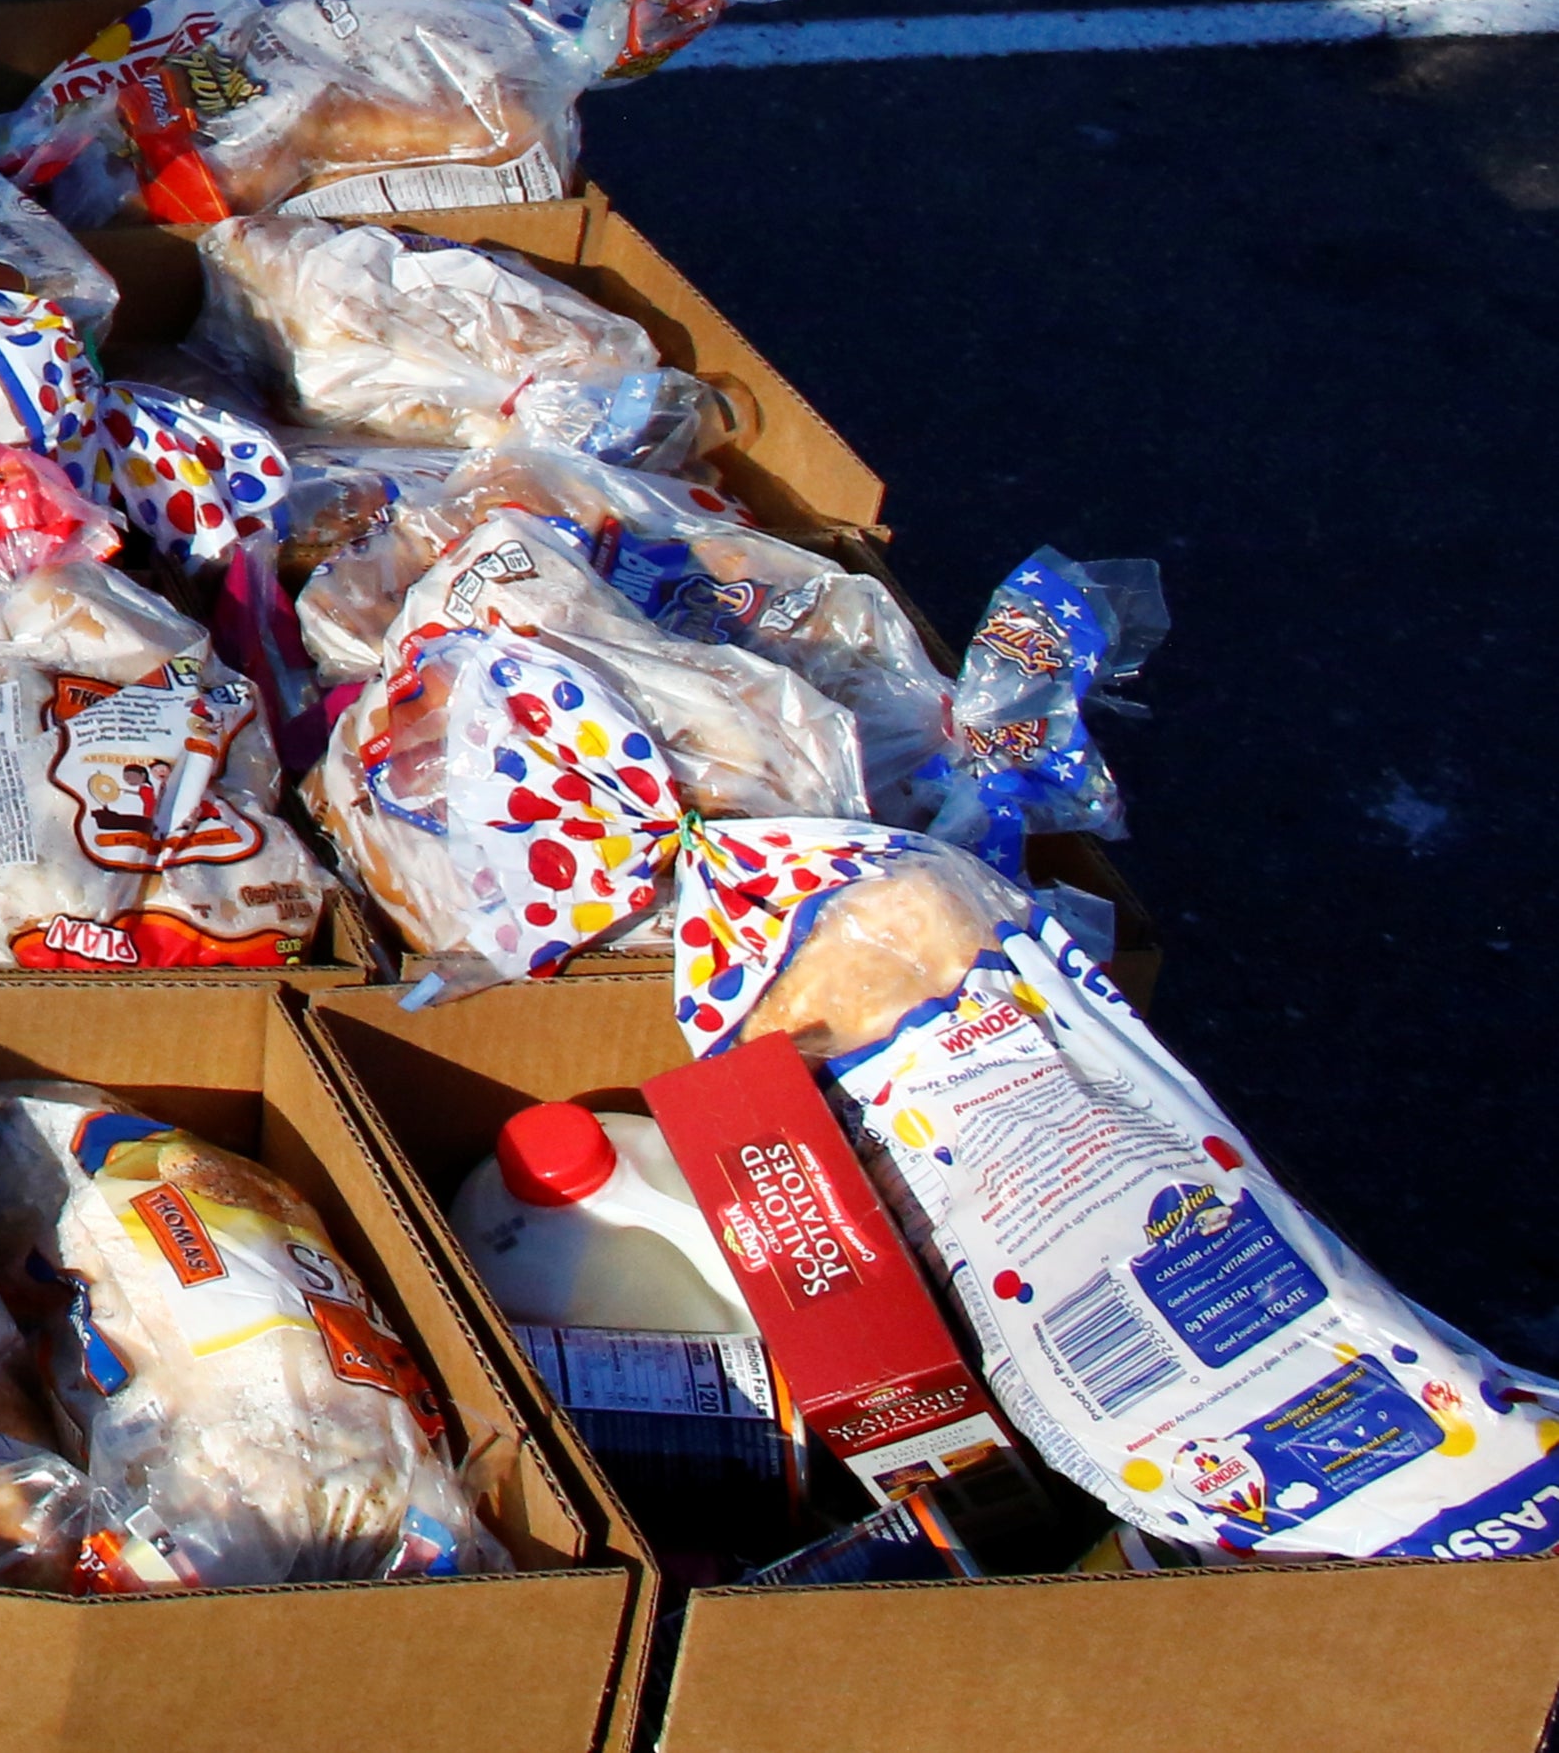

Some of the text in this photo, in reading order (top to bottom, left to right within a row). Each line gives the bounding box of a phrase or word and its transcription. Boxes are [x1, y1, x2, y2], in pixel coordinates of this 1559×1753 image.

[45, 915, 138, 963] PLAIN
[953, 1075, 1029, 1116] Reasons to
[797, 1141, 821, 1174] Sauce
[741, 1143, 830, 1298] SCALLOPED
[749, 1201, 783, 1255] CREAMY
[766, 1143, 850, 1279] POTATOES
[1100, 1193, 1122, 1213] enjoy
[1145, 1184, 1216, 1245] Nutrition
[148, 1193, 215, 1274] THOMAS'
[733, 1202, 769, 1270] LORETTA
[836, 1218, 877, 1263] Creamy
[1156, 1250, 1202, 1283] CALCIUM
[1167, 1289, 1188, 1309] Good
[1187, 1275, 1216, 1299] Source
[1222, 1242, 1264, 1276] VITAMIN
[1185, 1259, 1297, 1335] 0g TRANS FAT per serving
[1214, 1336, 1235, 1355] Good
[1234, 1322, 1261, 1343] Source
[1267, 1287, 1309, 1316] FOLATE
[1031, 1322, 1071, 1377] Purchase
[697, 1380, 720, 1414] 120
[751, 1378, 768, 1416] Facts
[1185, 1402, 1207, 1420] much
[1206, 1386, 1234, 1410] calcium
[1261, 1358, 1281, 1374] glass
[1288, 1339, 1307, 1355] milk
[1263, 1400, 1307, 1432] Questions
[1316, 1366, 1368, 1401] Comments?
[827, 1383, 969, 1435] SCALLOPED
[840, 1395, 966, 1442] POTATOES
[1074, 1390, 1102, 1424] Proof
[1194, 1460, 1245, 1497] WONDER
